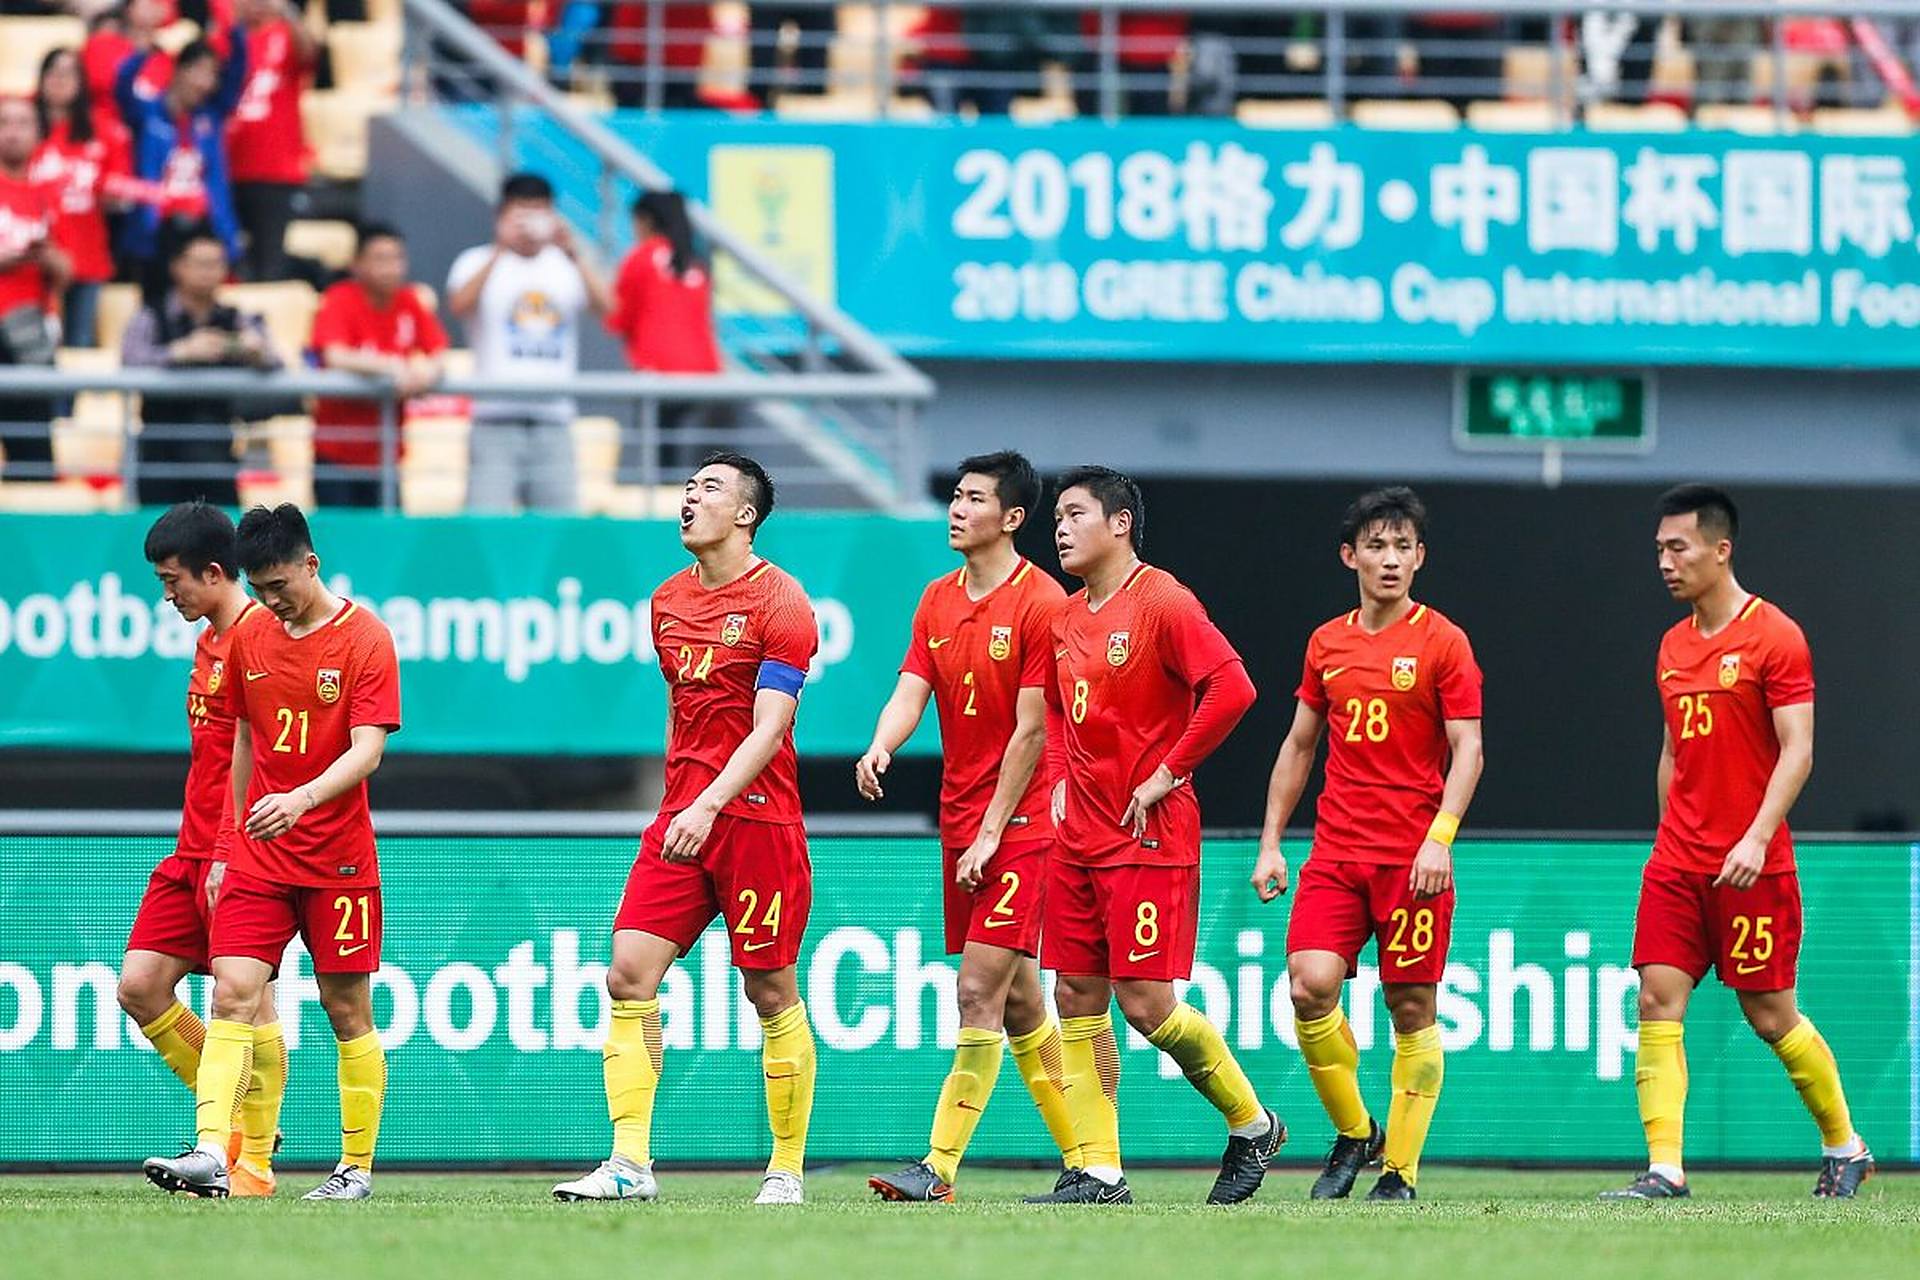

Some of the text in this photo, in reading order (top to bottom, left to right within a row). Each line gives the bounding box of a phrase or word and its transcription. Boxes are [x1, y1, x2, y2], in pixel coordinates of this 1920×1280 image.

[953, 141, 1919, 258] 2018格力·中国杯国际
[953, 261, 1079, 321] 2018
[1084, 260, 1229, 322] GREE
[1235, 261, 1385, 323] China
[1391, 262, 1497, 336] Cup
[1503, 265, 1822, 326] International
[679, 645, 714, 682] 24
[963, 672, 977, 716] 2
[1072, 680, 1089, 724] 8
[273, 708, 309, 755] 21
[1345, 698, 1389, 742] 28
[1679, 693, 1713, 740] 25
[735, 889, 782, 937] 24
[993, 872, 1020, 916] 2
[334, 896, 369, 940] 21
[1135, 902, 1159, 946] 8
[1387, 908, 1434, 952] 28
[1730, 915, 1773, 961] 25
